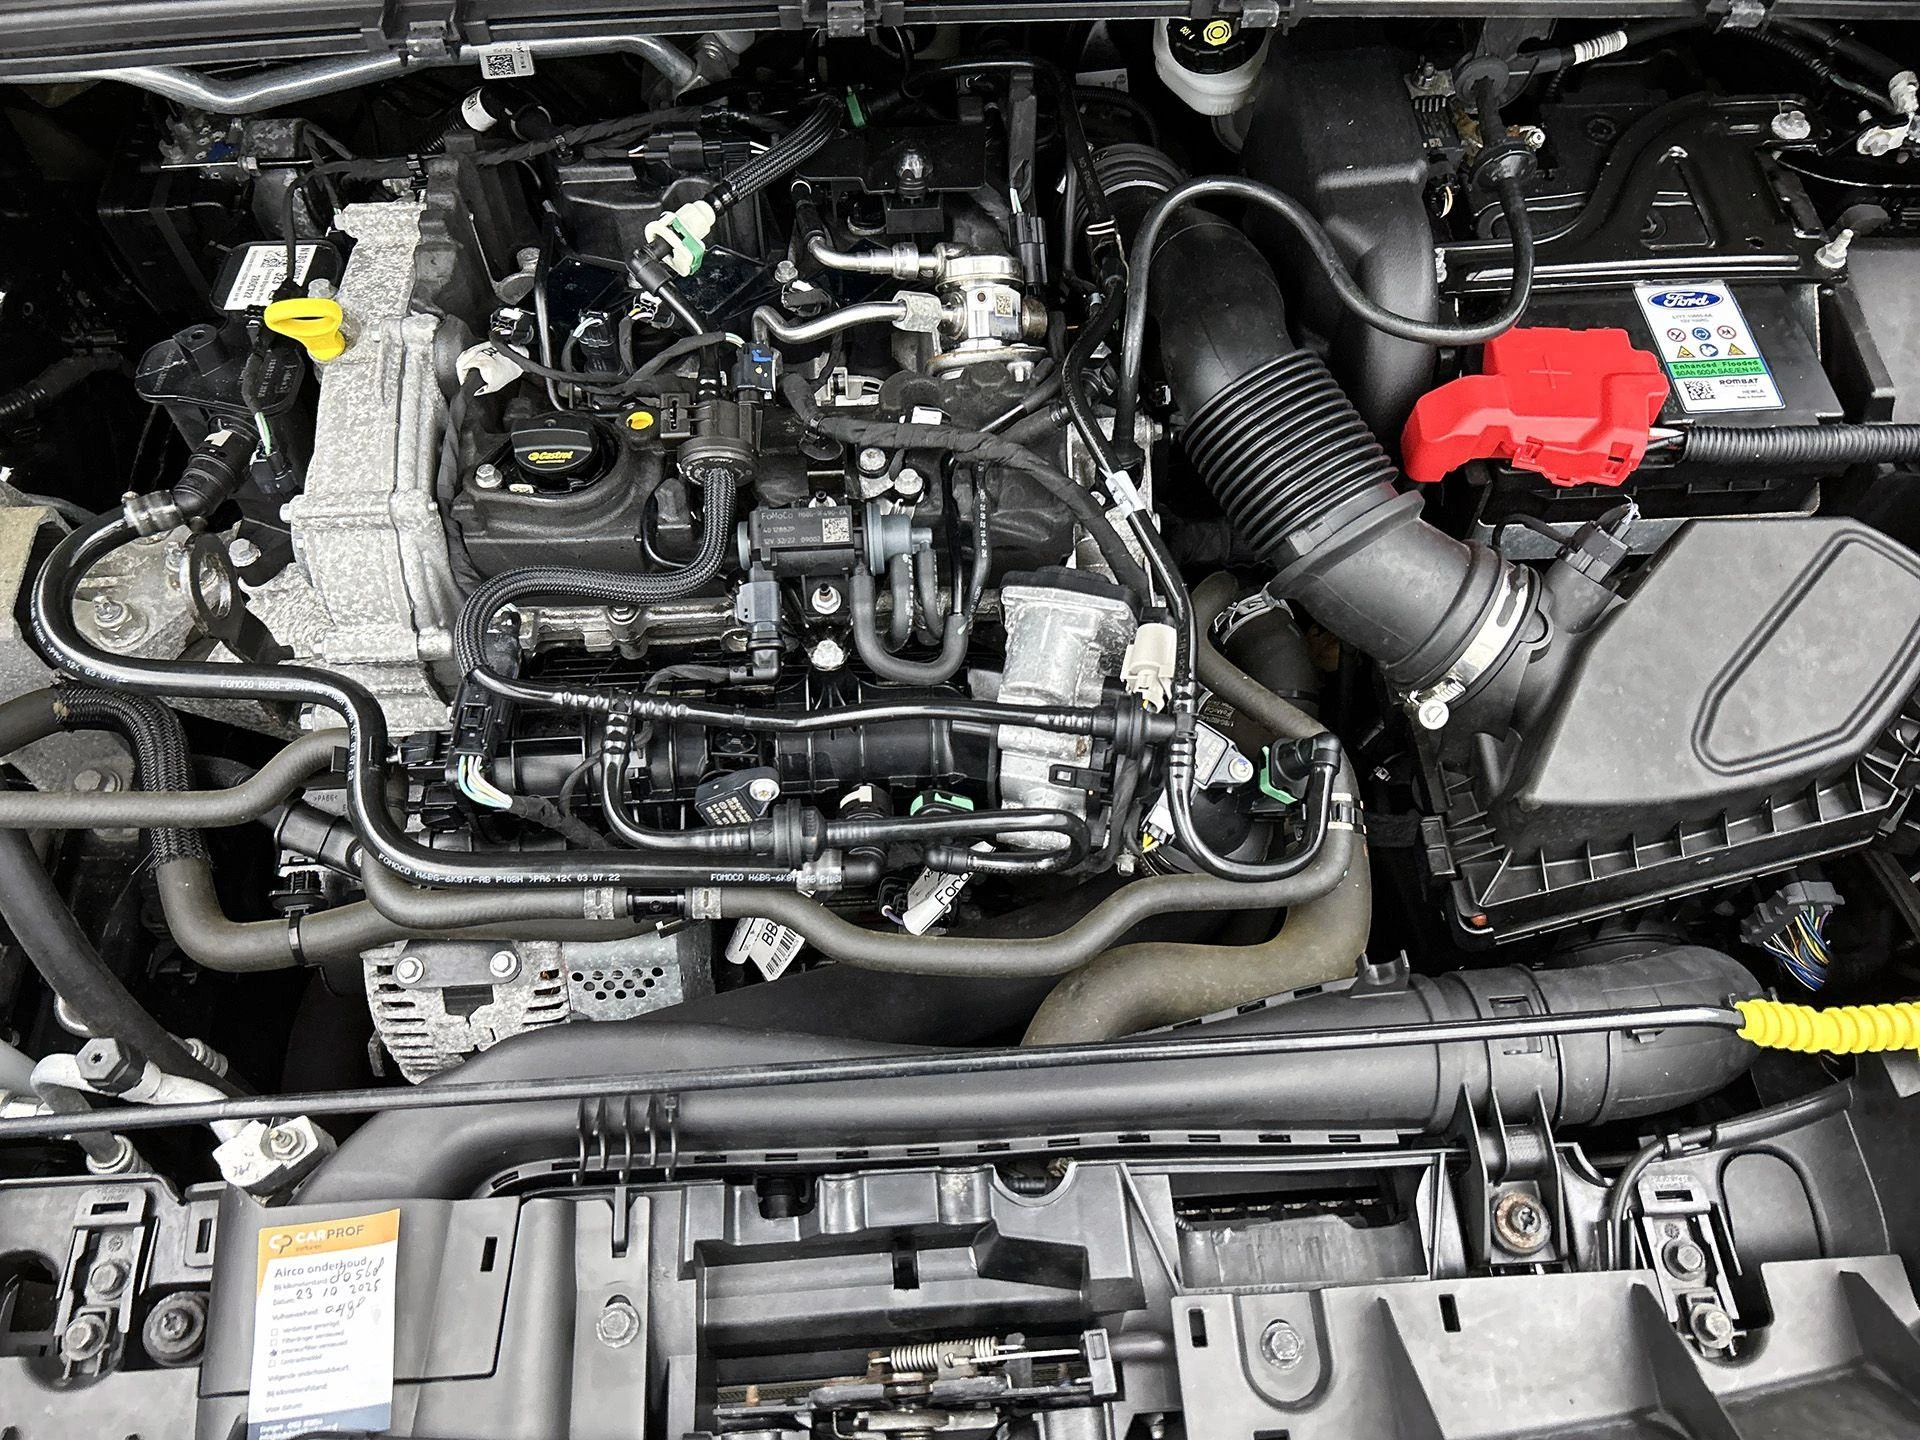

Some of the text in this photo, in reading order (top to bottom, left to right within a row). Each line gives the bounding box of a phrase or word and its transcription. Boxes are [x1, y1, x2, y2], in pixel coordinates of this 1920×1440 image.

[1663, 292, 1710, 308] Ford
[1673, 359, 1759, 370] Enhanced Flooded
[539, 451, 574, 460] Castrol
[378, 853, 411, 875] FOMOCO
[576, 872, 621, 882] 03.07.22
[710, 873, 744, 881] FOMOCO
[295, 1225, 365, 1244] CARPROF
[274, 1256, 368, 1279] Airco onderhoud
[296, 1287, 313, 1300] 23
